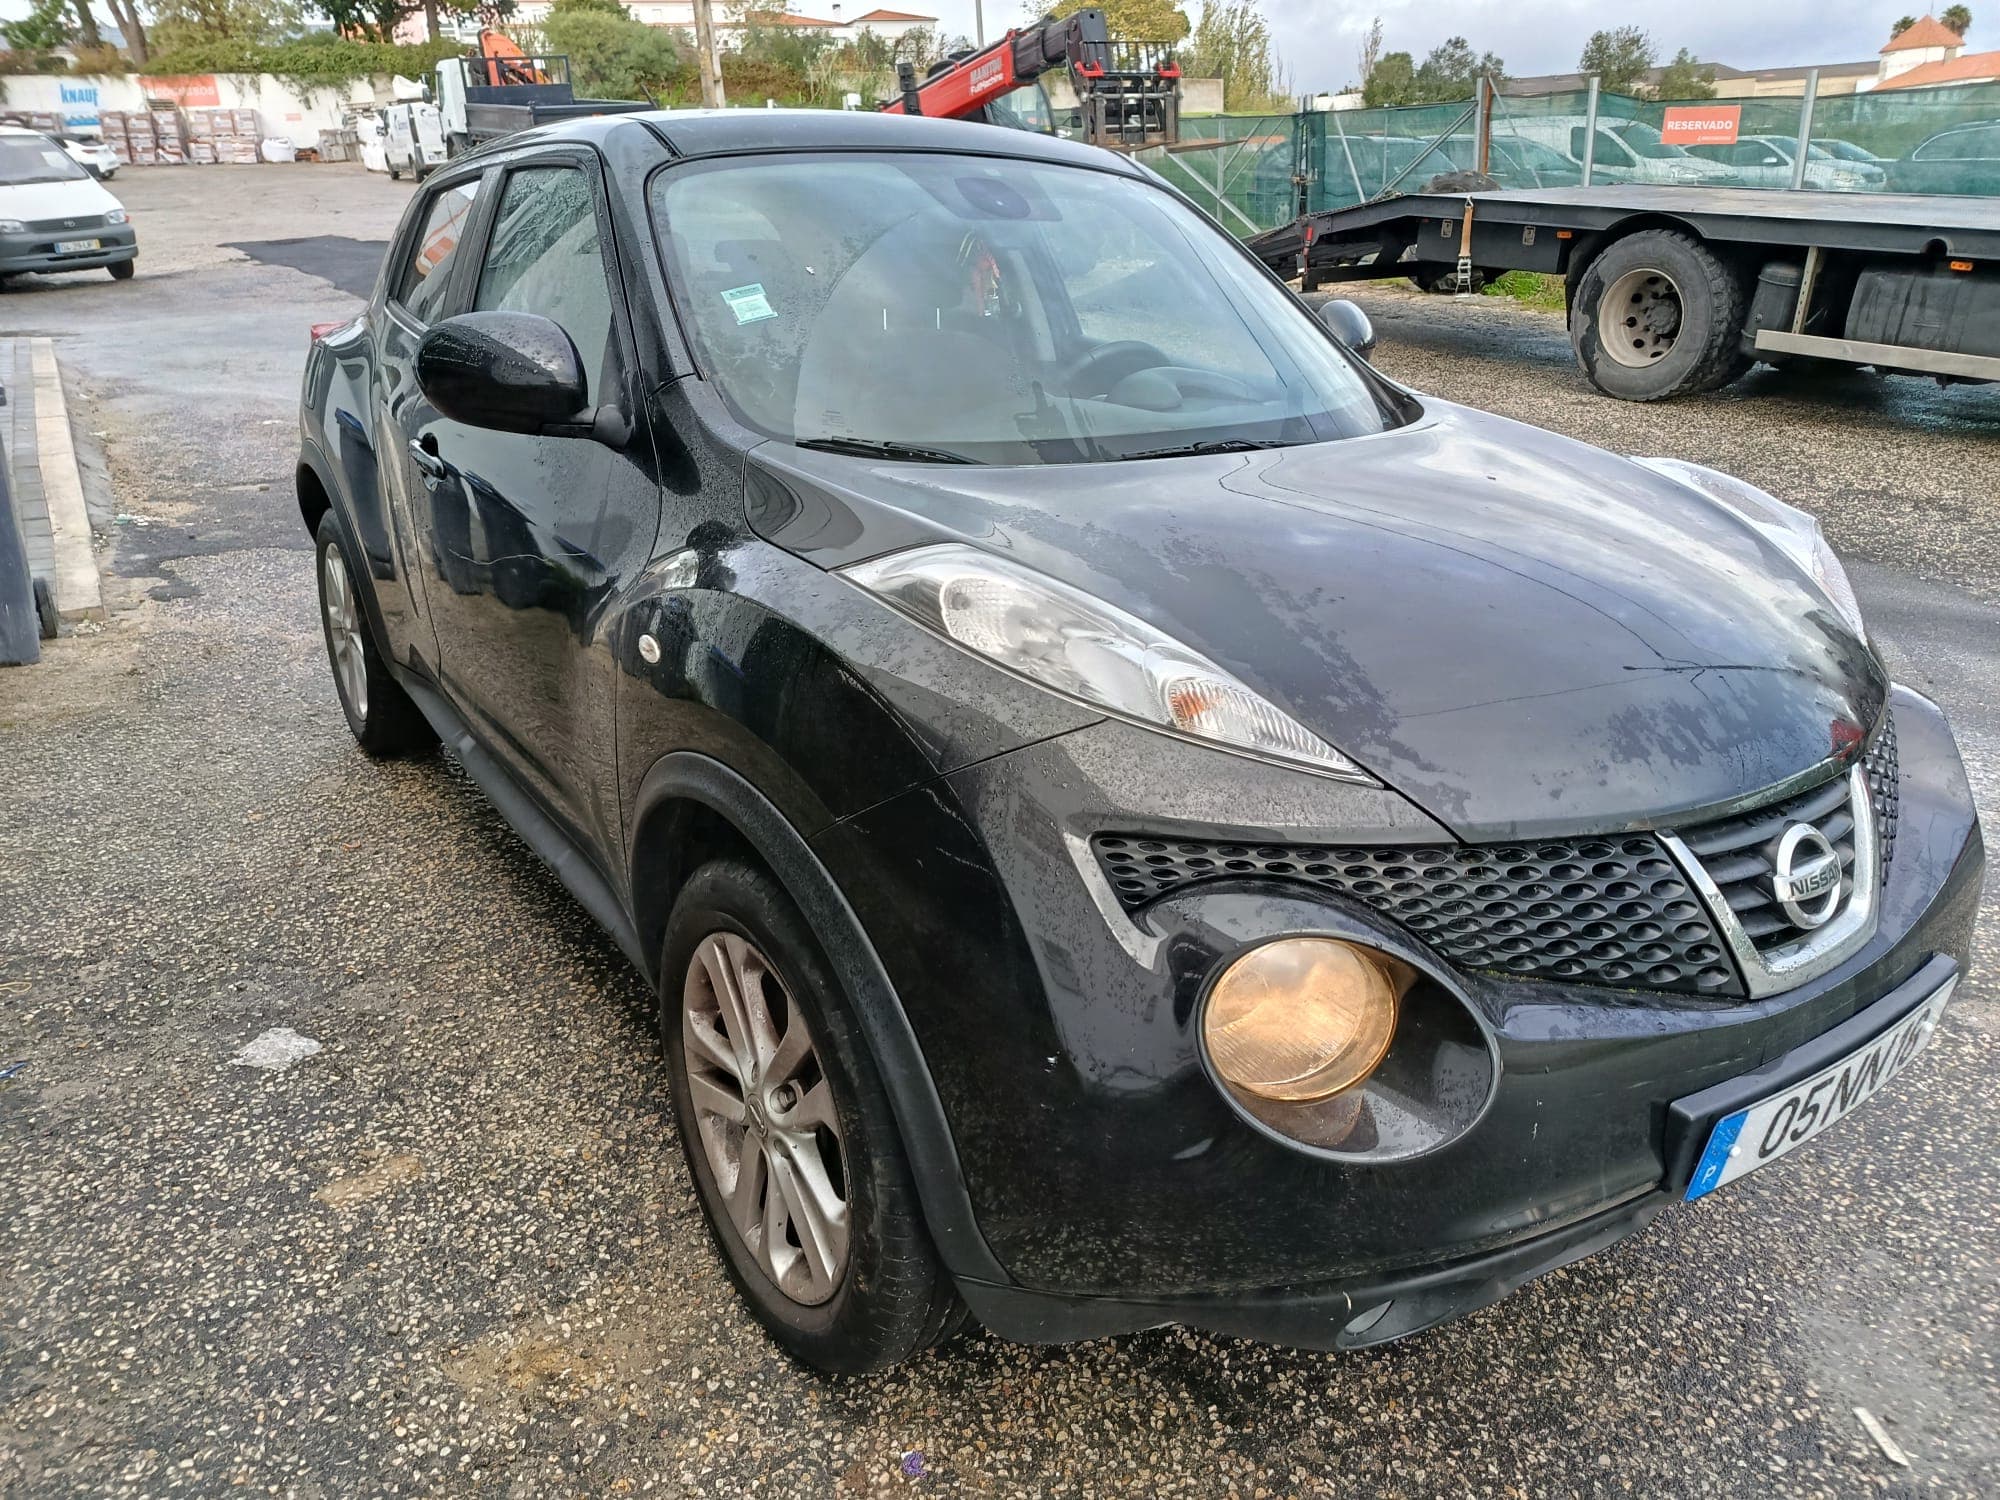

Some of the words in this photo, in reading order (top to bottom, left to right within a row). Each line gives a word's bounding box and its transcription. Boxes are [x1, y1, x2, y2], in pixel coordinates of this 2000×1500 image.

[1667, 120, 1733, 131] RESERVADO
[1789, 862, 1841, 897] NISSAN
[1701, 1165, 1717, 1185] P
